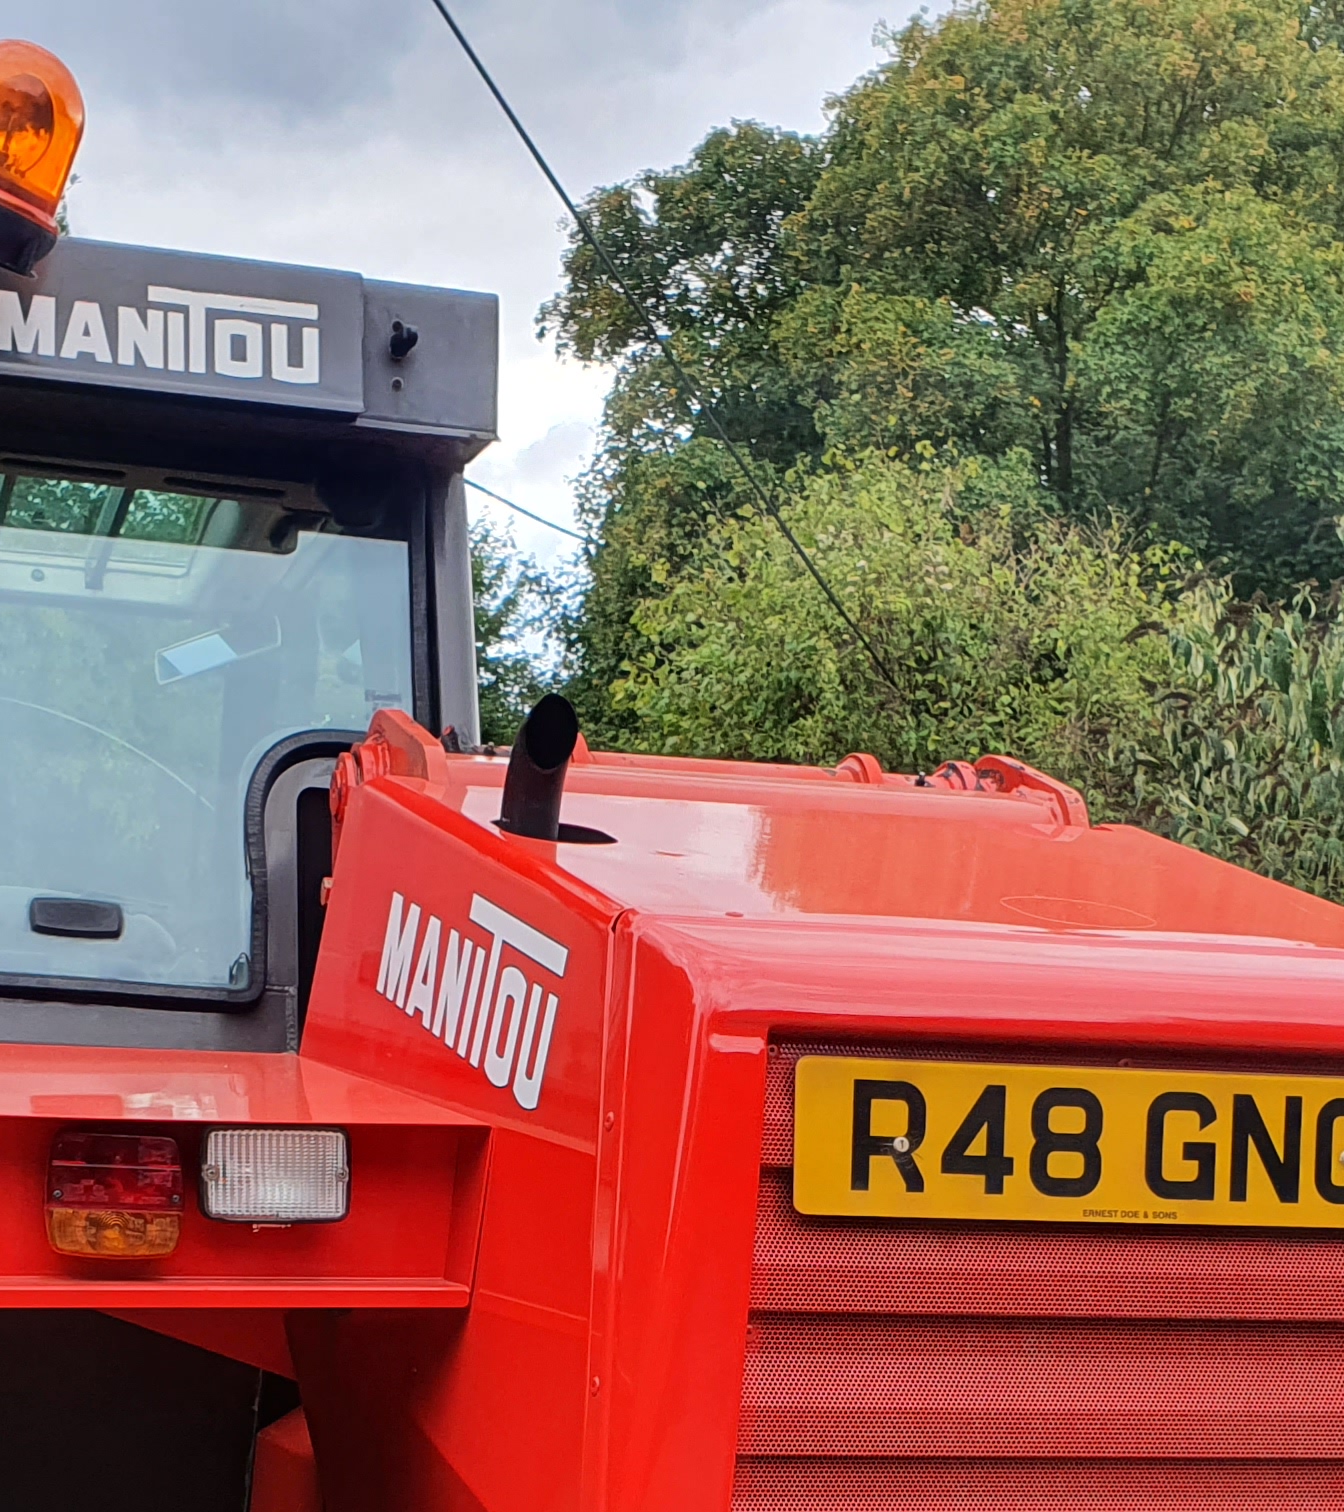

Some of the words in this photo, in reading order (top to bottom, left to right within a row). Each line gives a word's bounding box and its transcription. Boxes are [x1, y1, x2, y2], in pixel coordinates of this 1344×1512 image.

[375, 890, 569, 1110] MANITOU
[850, 1078, 1104, 1198] R48
[1082, 1209, 1118, 1218] ERNEST
[1121, 1210, 1140, 1219] DOE
[1152, 1211, 1178, 1220] SONS
